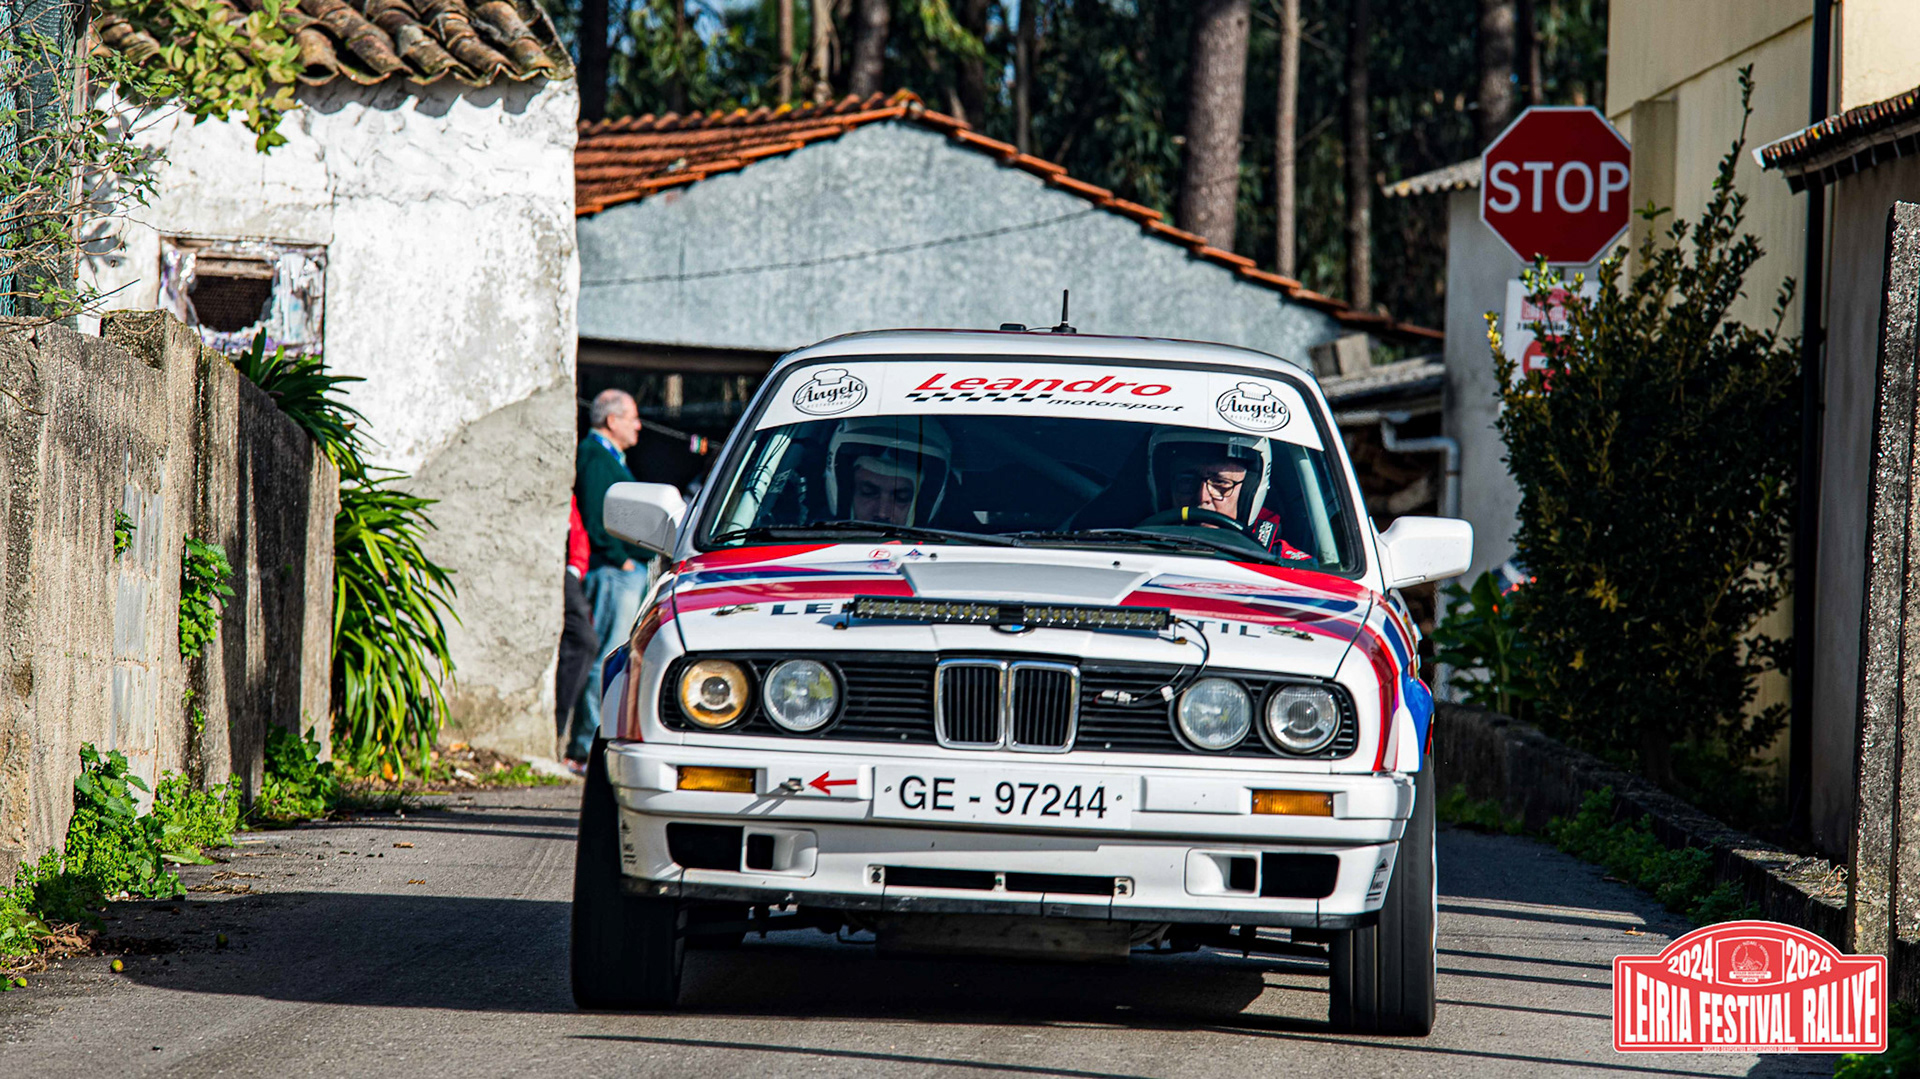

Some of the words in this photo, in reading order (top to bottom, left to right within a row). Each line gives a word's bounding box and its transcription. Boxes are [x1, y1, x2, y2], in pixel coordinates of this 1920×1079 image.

[1488, 161, 1630, 213] STOP
[914, 373, 1172, 396] Leandro
[1047, 399, 1184, 412] motorsport
[899, 775, 956, 811] GE
[994, 781, 1108, 819] 97244
